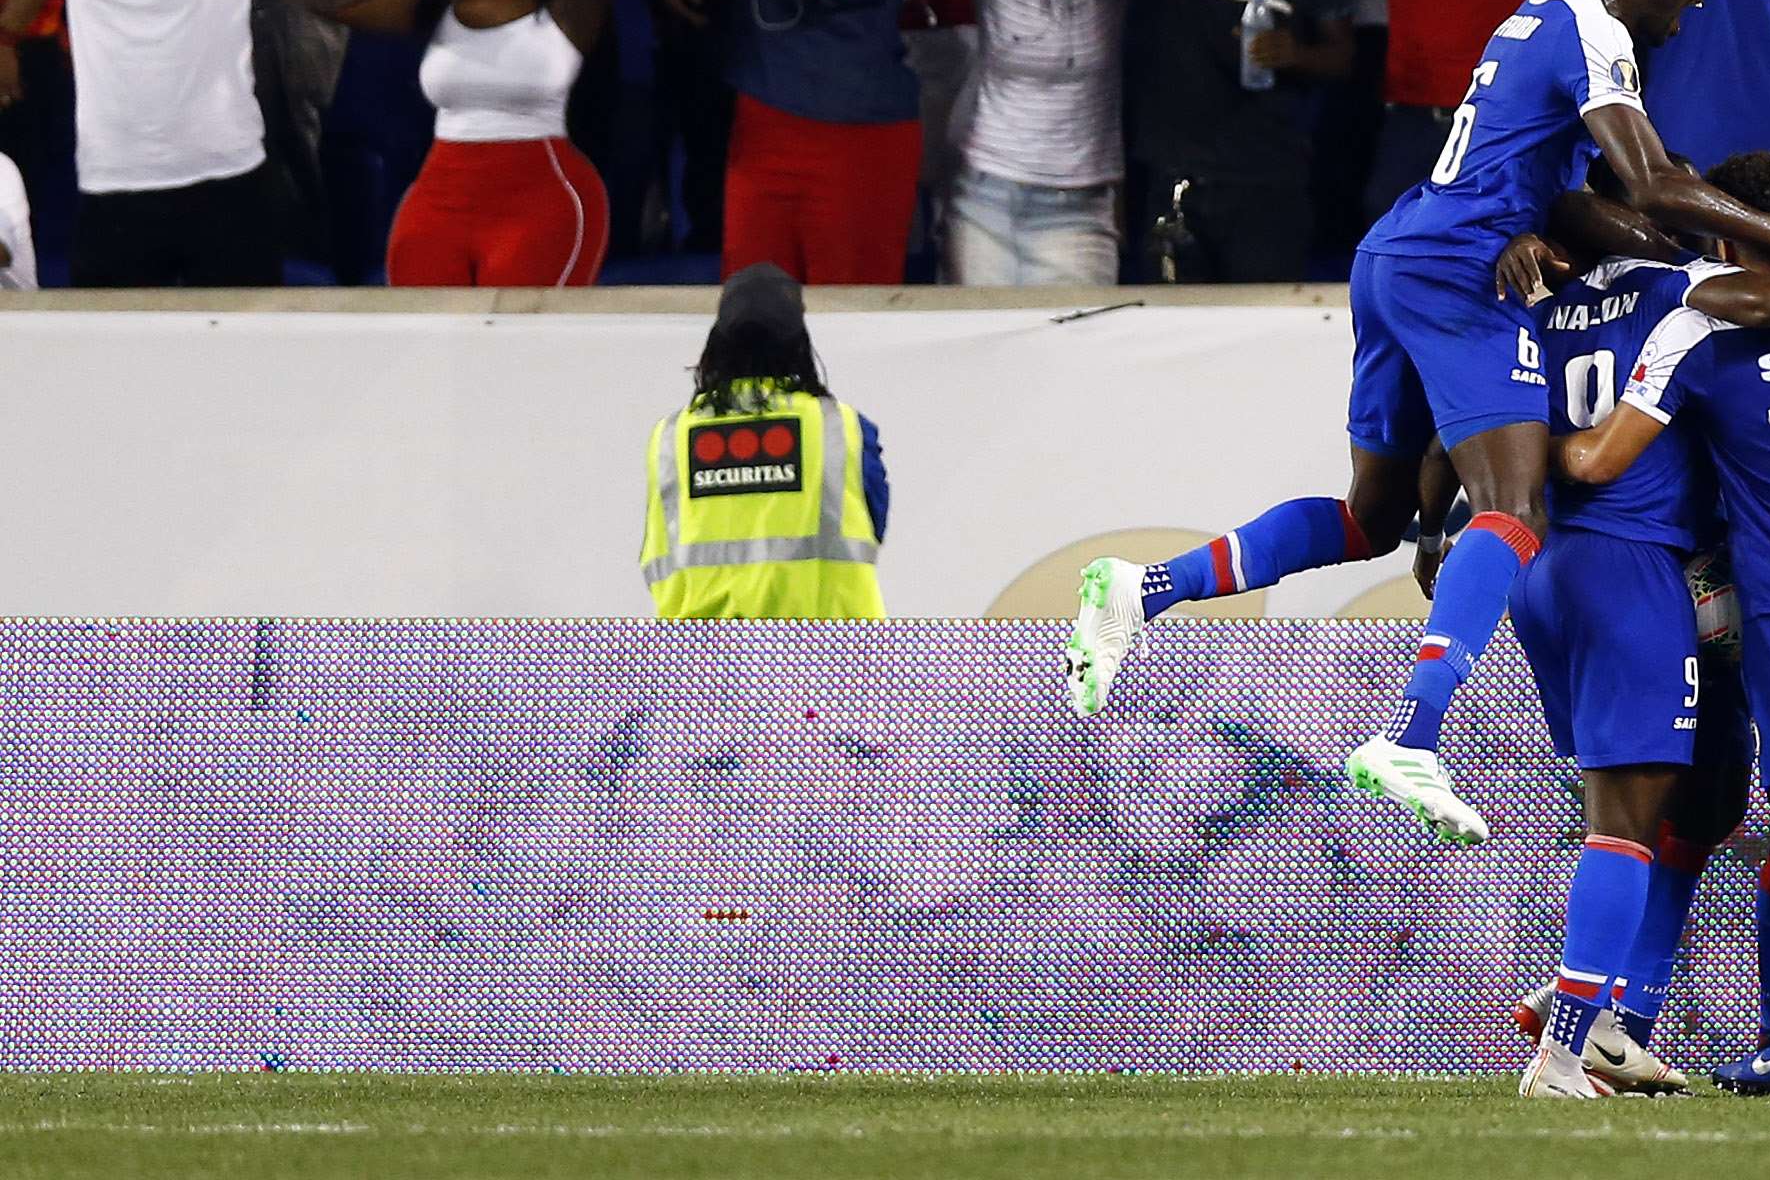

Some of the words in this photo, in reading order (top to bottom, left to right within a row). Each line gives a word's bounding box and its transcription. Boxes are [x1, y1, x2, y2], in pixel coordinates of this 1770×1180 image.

[1431, 60, 1499, 185] 6
[1518, 327, 1540, 369] 6
[694, 463, 796, 489] SECURITAS
[1684, 656, 1699, 708] 9
